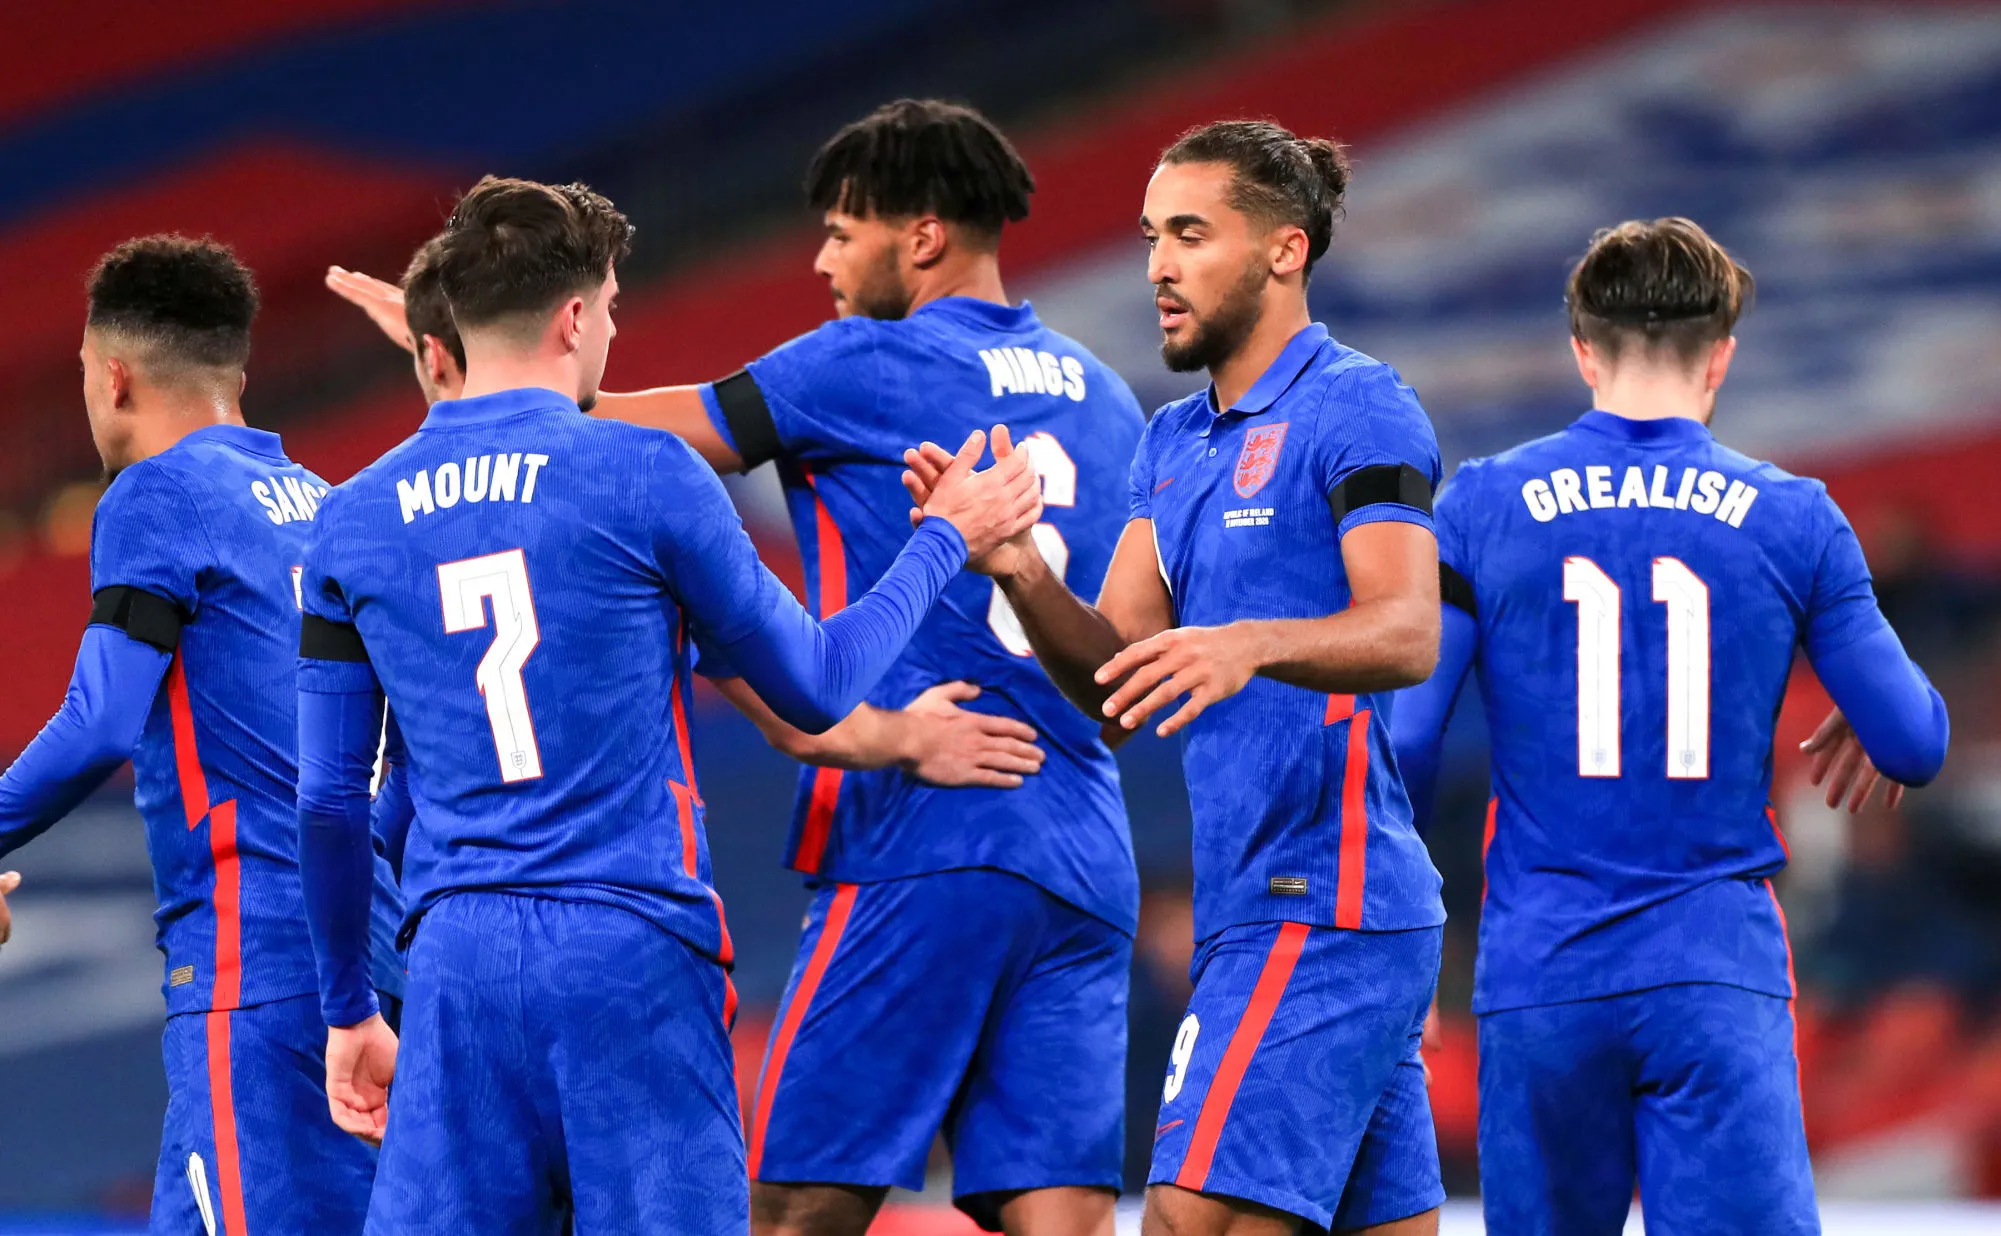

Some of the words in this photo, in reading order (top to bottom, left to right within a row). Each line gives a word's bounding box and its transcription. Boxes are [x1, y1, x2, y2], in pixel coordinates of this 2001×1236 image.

[978, 347, 1085, 402] MINGS
[251, 476, 328, 526] SANC
[396, 453, 549, 524] MOUNT
[1521, 465, 1759, 528] GREALISH
[436, 548, 544, 784] 7
[1563, 555, 1711, 779] 11
[1163, 1013, 1201, 1104] 9
